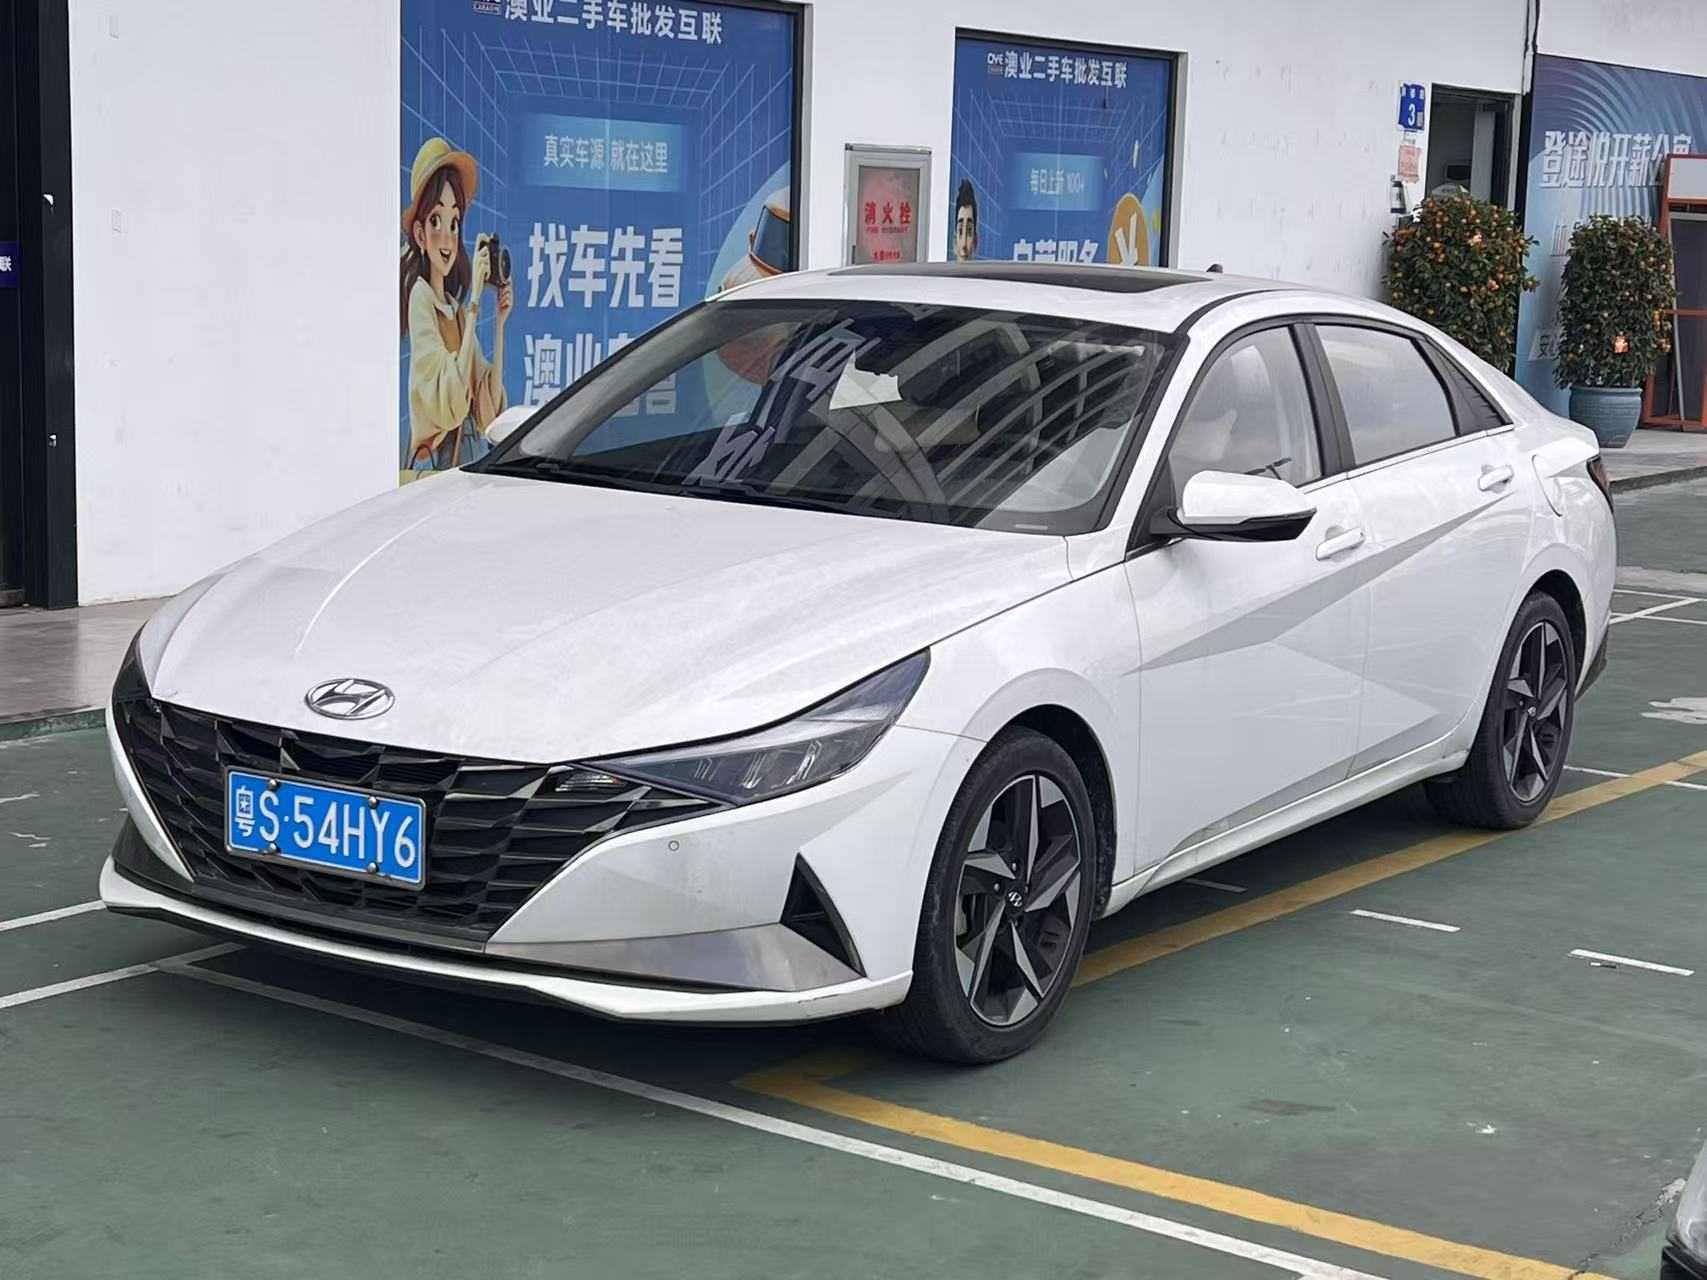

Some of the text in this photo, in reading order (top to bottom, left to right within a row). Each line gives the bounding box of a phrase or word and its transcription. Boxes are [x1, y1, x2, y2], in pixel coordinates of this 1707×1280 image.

[504, 0, 723, 45] 澳业二手车批发互联
[1004, 50, 1127, 89] 澳业二手车批发互联
[543, 135, 668, 173] 真实车源 就在这里
[864, 201, 912, 225] 消火栓
[527, 222, 684, 308] 找车先看
